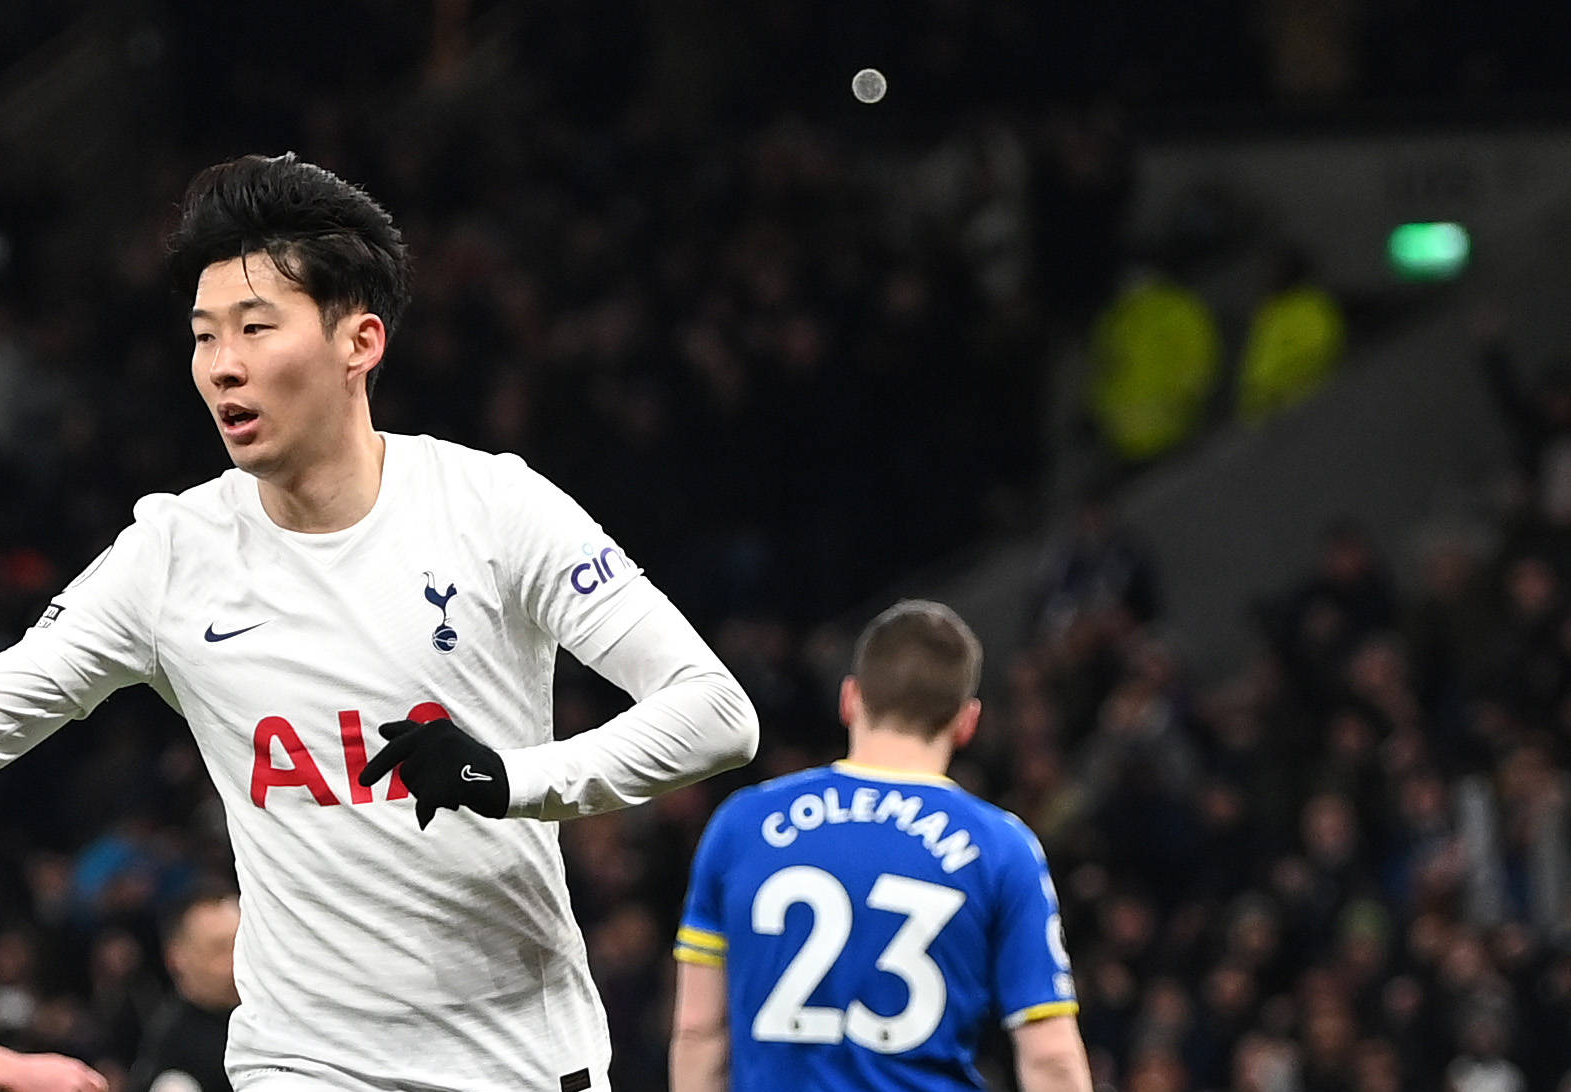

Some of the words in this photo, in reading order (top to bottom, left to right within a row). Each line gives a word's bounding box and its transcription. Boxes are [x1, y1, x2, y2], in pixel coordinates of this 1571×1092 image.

[571, 543, 631, 595] cin
[761, 786, 980, 874] COLEMAN
[751, 864, 967, 1054] 23
